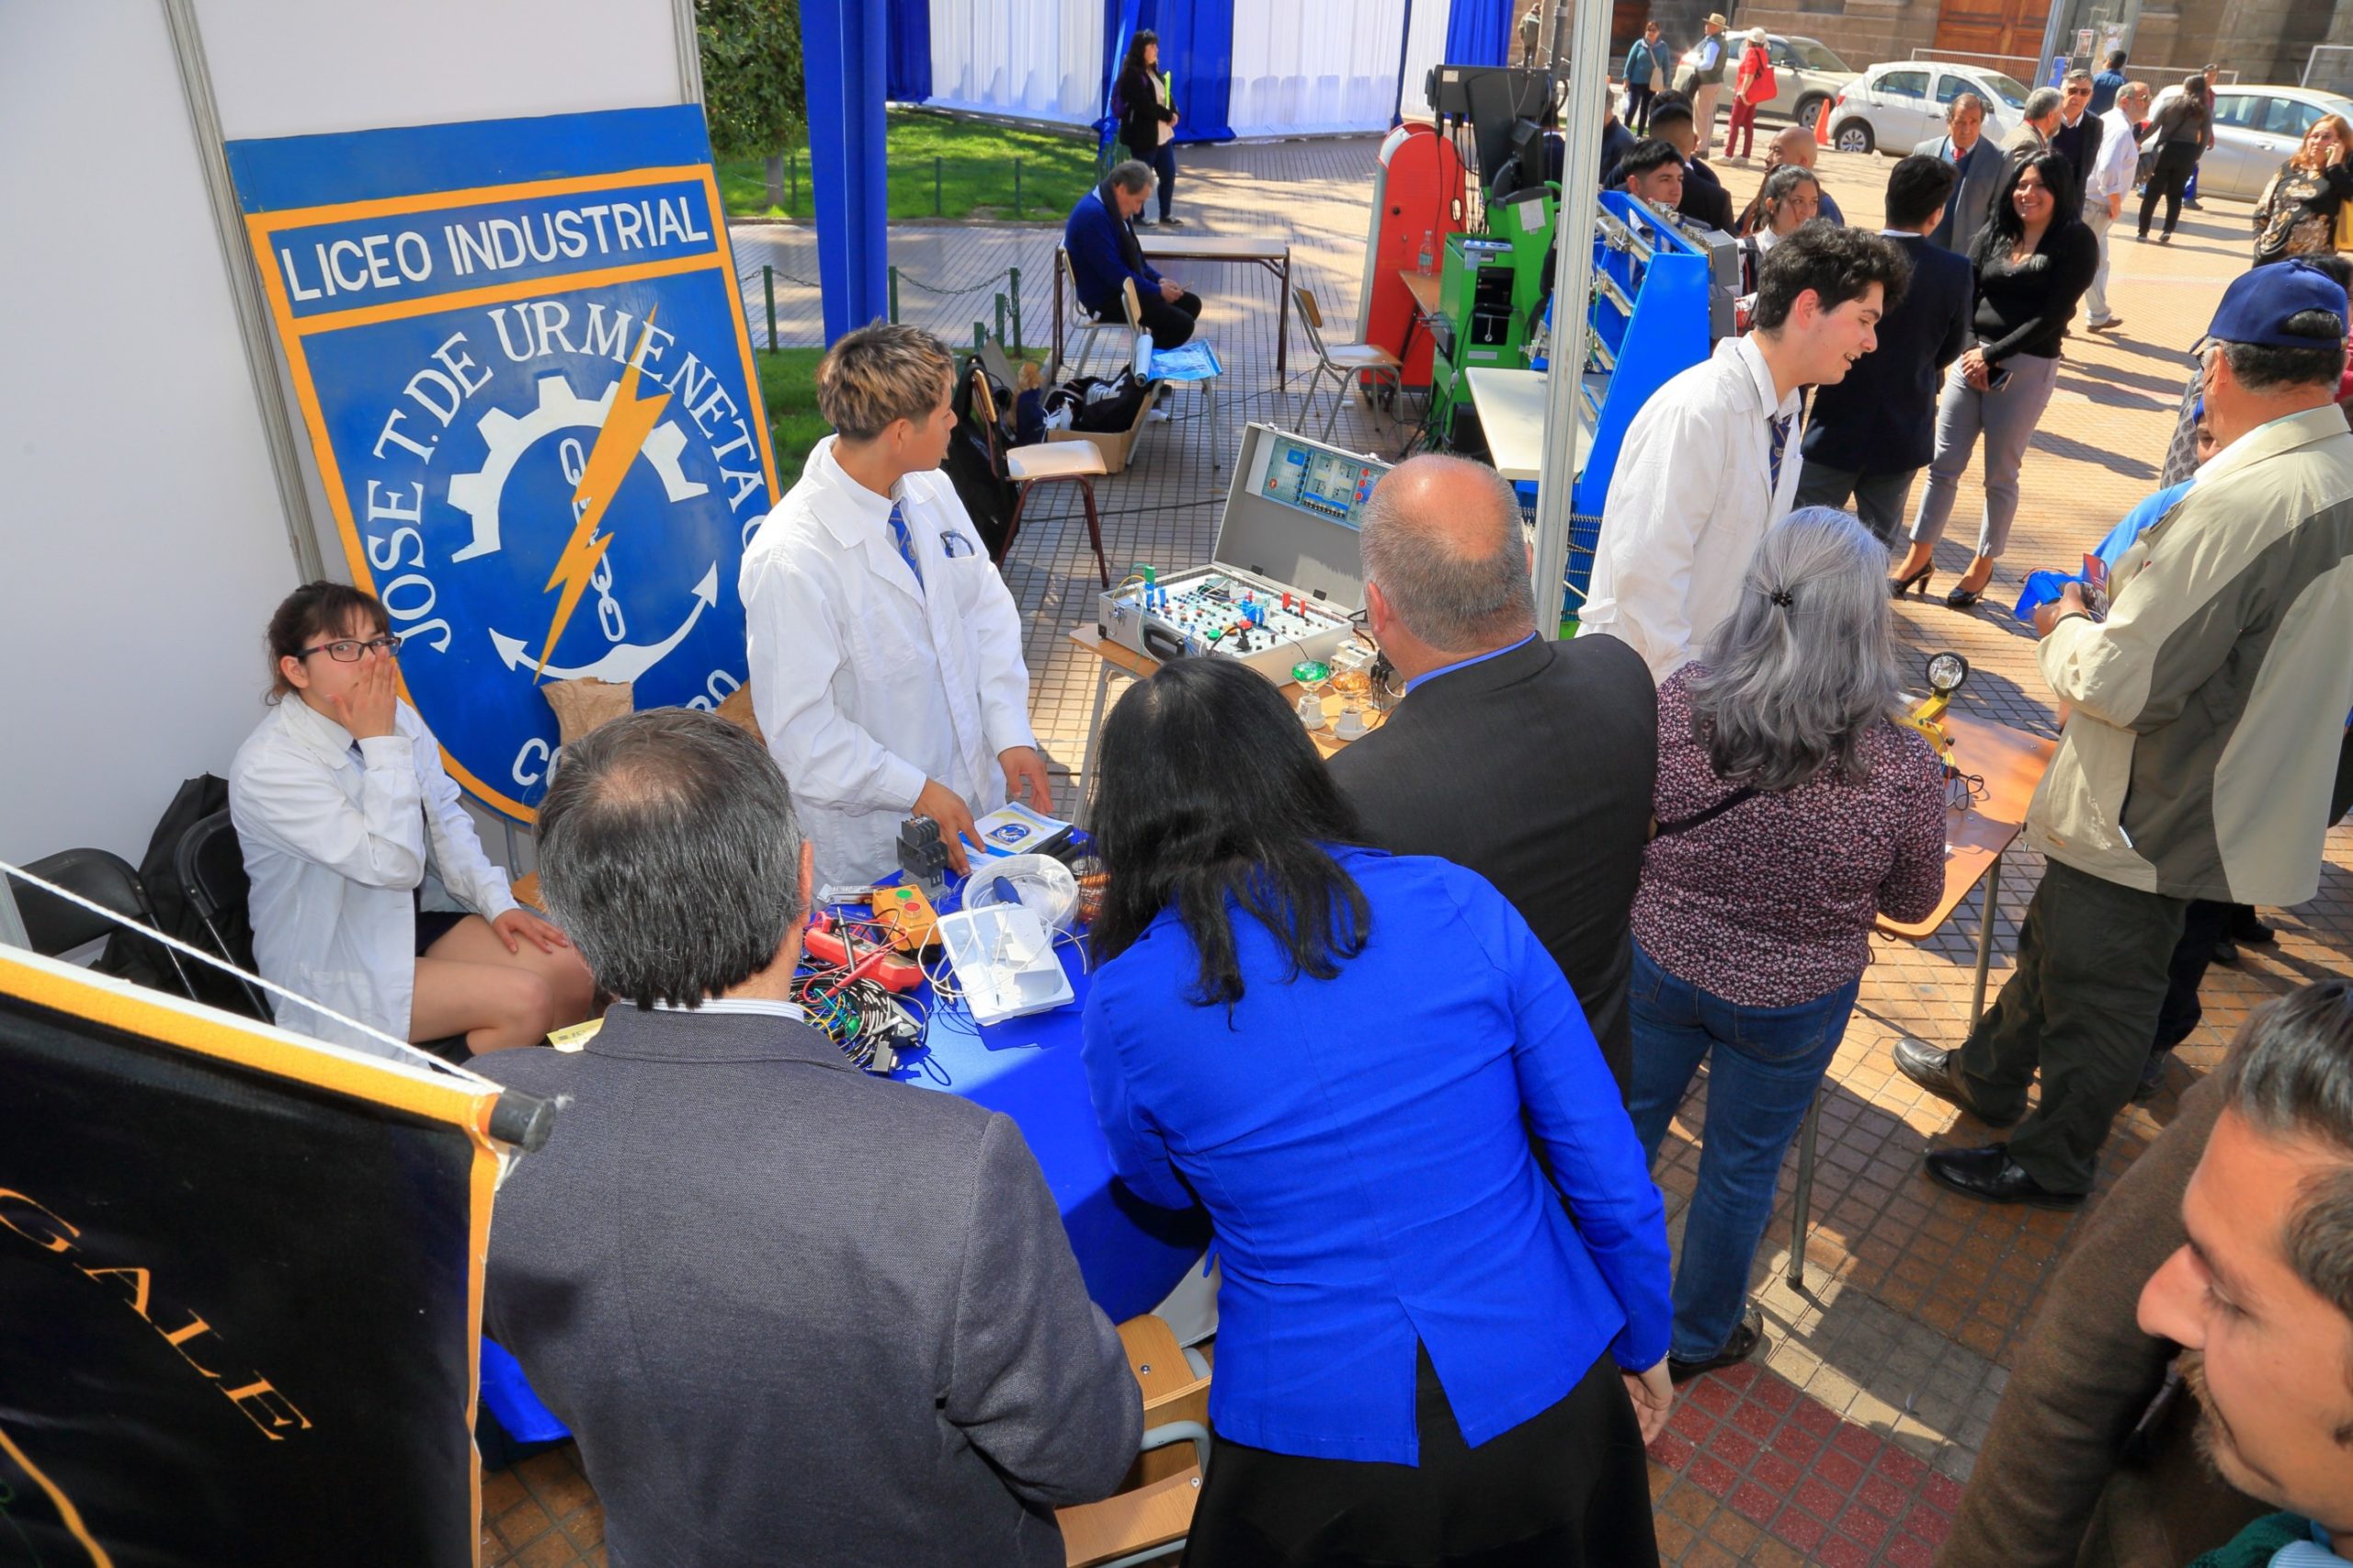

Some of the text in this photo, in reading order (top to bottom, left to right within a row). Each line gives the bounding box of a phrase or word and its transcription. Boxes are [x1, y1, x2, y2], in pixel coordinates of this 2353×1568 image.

[280, 196, 709, 301] LICEO INDUSTRIAL
[368, 479, 451, 653] JOSE
[487, 301, 765, 515] URMENETA
